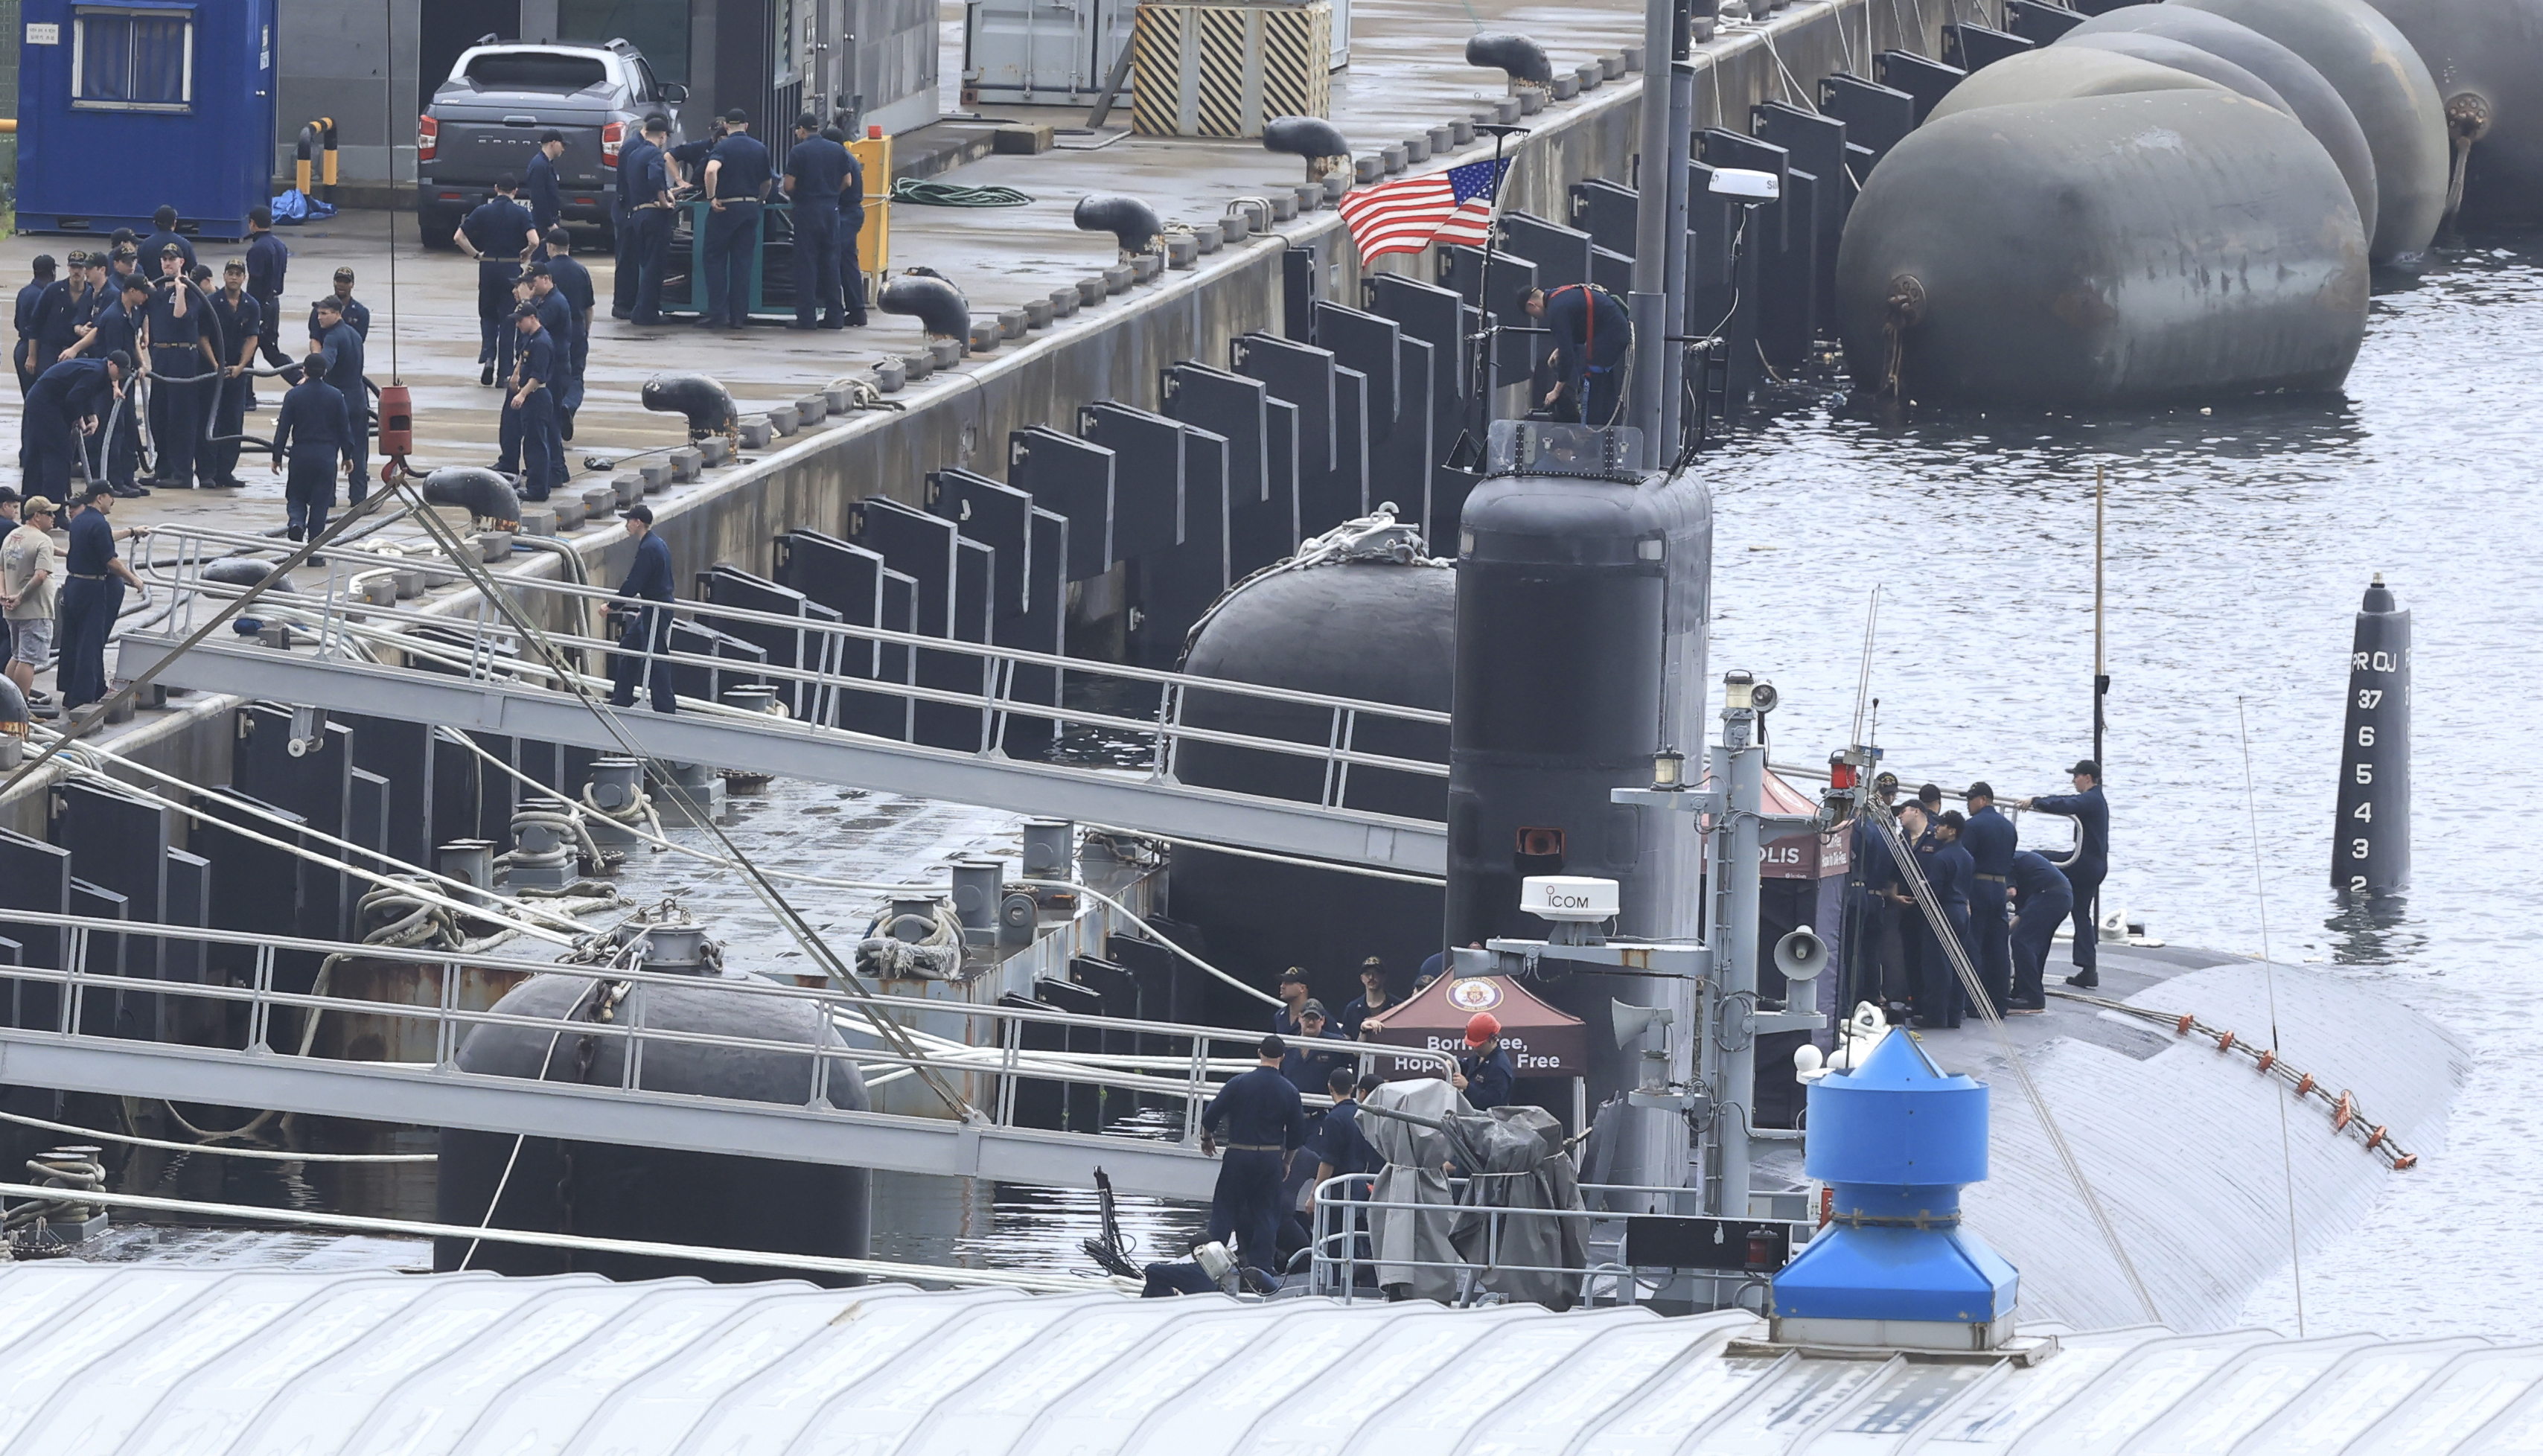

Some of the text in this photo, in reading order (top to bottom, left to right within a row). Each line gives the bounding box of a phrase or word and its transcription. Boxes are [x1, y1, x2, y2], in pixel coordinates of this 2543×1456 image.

[2358, 689, 2382, 709] 37
[2358, 726, 2375, 747] 6
[2356, 764, 2373, 785] 5
[2354, 802, 2372, 823] 4
[2352, 838, 2369, 859] 3
[2350, 875, 2367, 893] 2
[1500, 1038, 1528, 1052] ee,
[1517, 1054, 1560, 1068] Free
